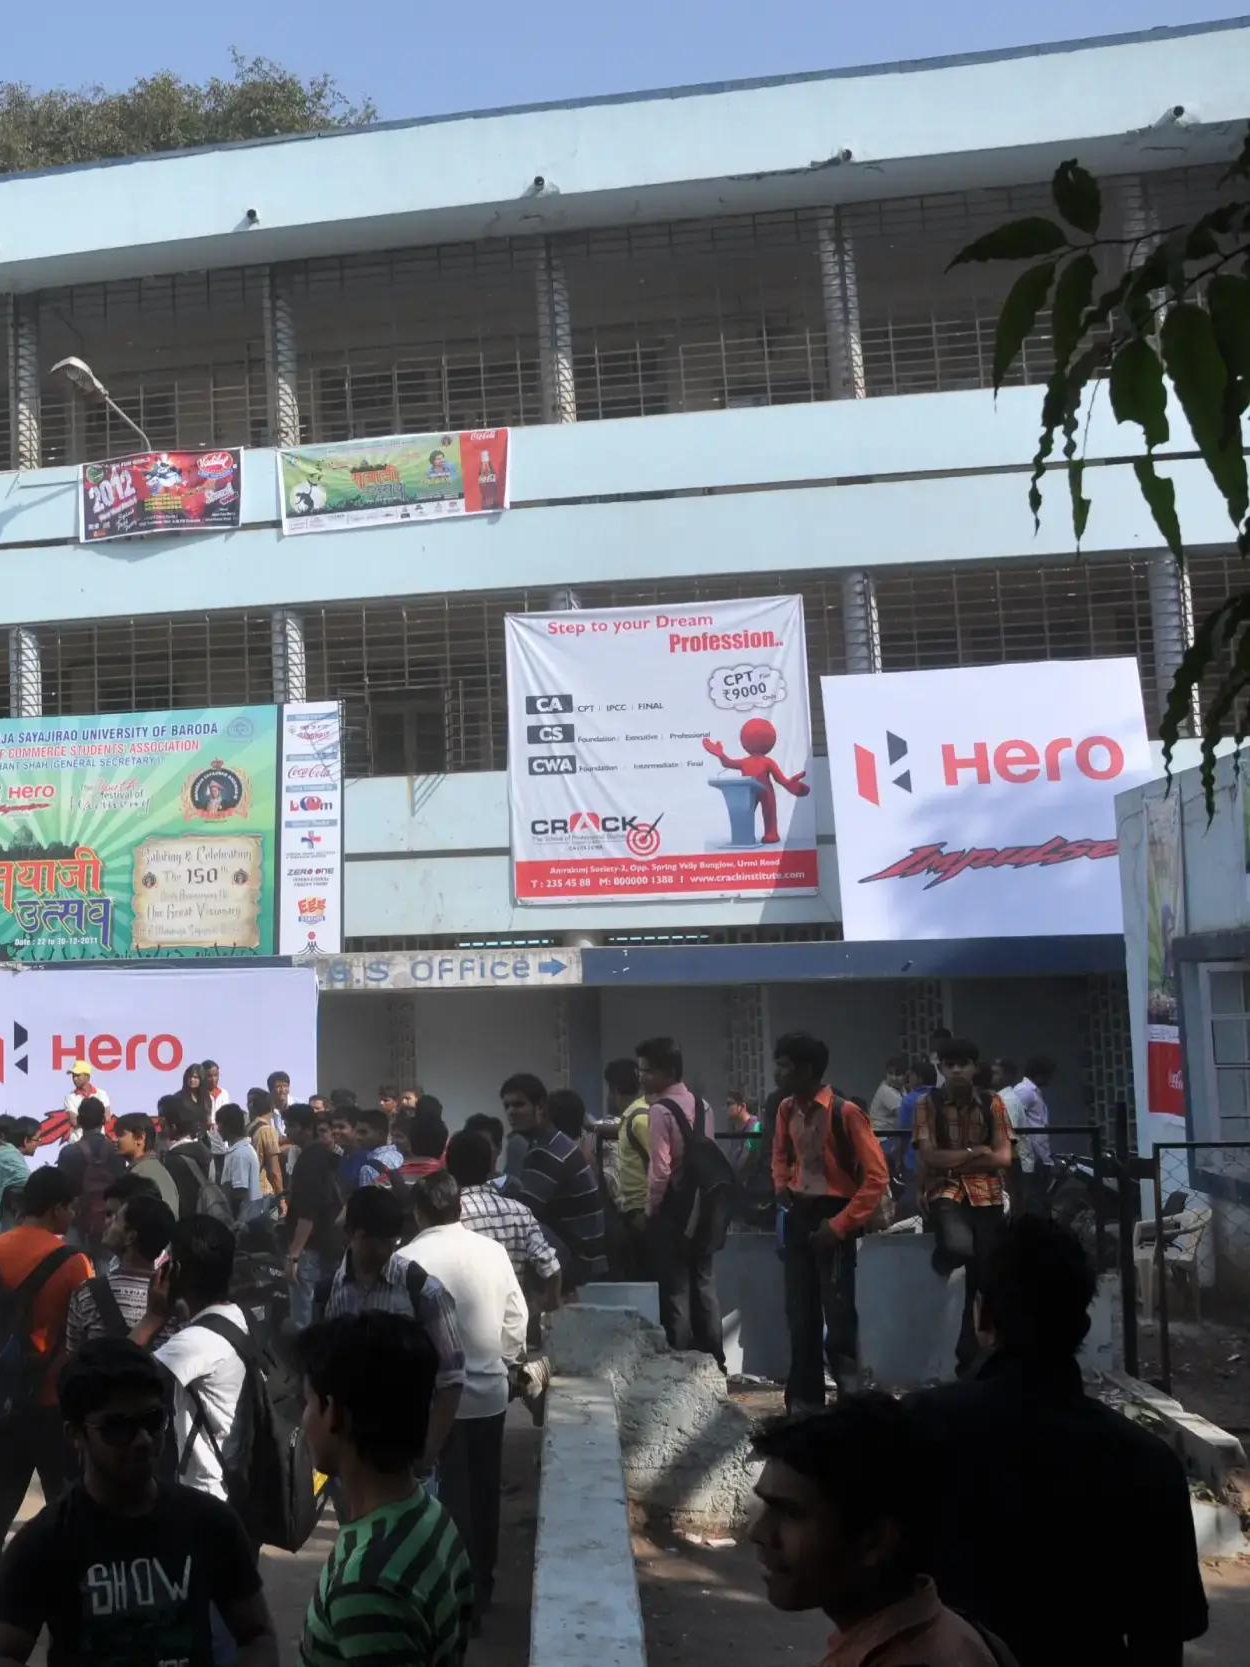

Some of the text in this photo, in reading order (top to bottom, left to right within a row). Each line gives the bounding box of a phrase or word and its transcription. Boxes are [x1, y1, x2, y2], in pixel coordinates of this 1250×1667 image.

[88, 470, 136, 514] 2012
[548, 614, 713, 637] Step to your Dream
[669, 630, 784, 653] Profession..
[723, 670, 753, 686] CPT
[536, 697, 564, 712] CA
[638, 702, 664, 710] FINAL
[18, 730, 78, 743] SAYAJIRAO
[82, 727, 148, 740] UNIVERSITY
[152, 725, 167, 737] OF
[171, 722, 218, 736] BARODA
[539, 727, 564, 741] CS
[669, 731, 711, 739] Professional
[8, 746, 67, 758] COMMERCE
[129, 740, 199, 754] ASSOCIATION
[23, 761, 48, 770] SHAH
[53, 759, 96, 769] GENERAL
[99, 757, 154, 767] SECRETARY
[532, 756, 573, 772] CWA
[579, 764, 618, 772] Foundation
[941, 734, 1125, 786] Hero
[8, 784, 55, 799] Hero
[531, 812, 639, 835] CRACK
[630, 862, 650, 873] Opp.
[652, 861, 677, 872] Spring
[737, 857, 758, 866] Urmi
[760, 855, 780, 864] Road
[187, 868, 217, 883] 150
[546, 878, 563, 887] 235
[580, 877, 591, 887] 88
[651, 874, 673, 884] 1388
[690, 870, 805, 884] www.crackinstitute.com
[14, 898, 114, 951] उत्सव
[57, 937, 98, 945] 30-12-2011
[52, 1033, 184, 1072] Hero
[87, 1556, 192, 1615] SHOW
